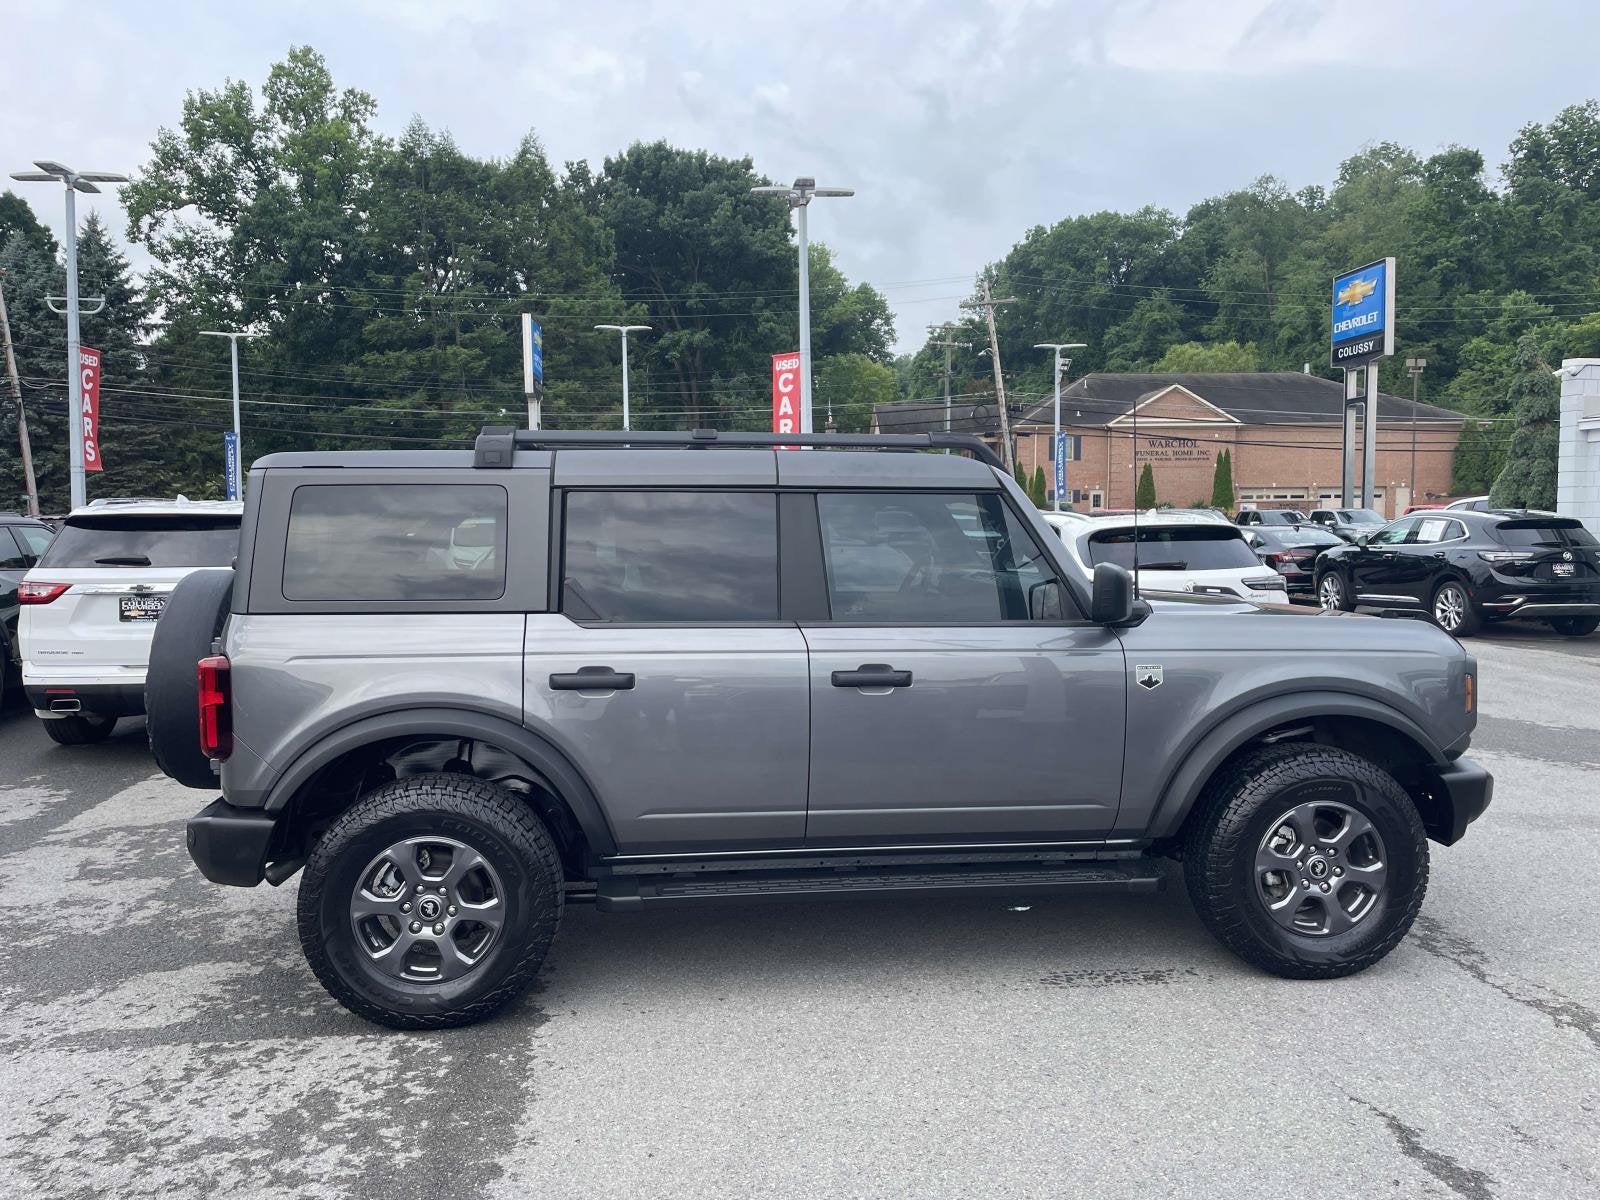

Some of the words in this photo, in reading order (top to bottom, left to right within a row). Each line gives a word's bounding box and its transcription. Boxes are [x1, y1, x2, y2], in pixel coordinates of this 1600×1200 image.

[1334, 312, 1378, 333] CHEVROLET
[1338, 341, 1374, 358] COLUSSY
[80, 353, 98, 367] USED
[776, 359, 799, 370] USED
[82, 369, 95, 462] CARS
[1148, 440, 1200, 448] WARCHOL
